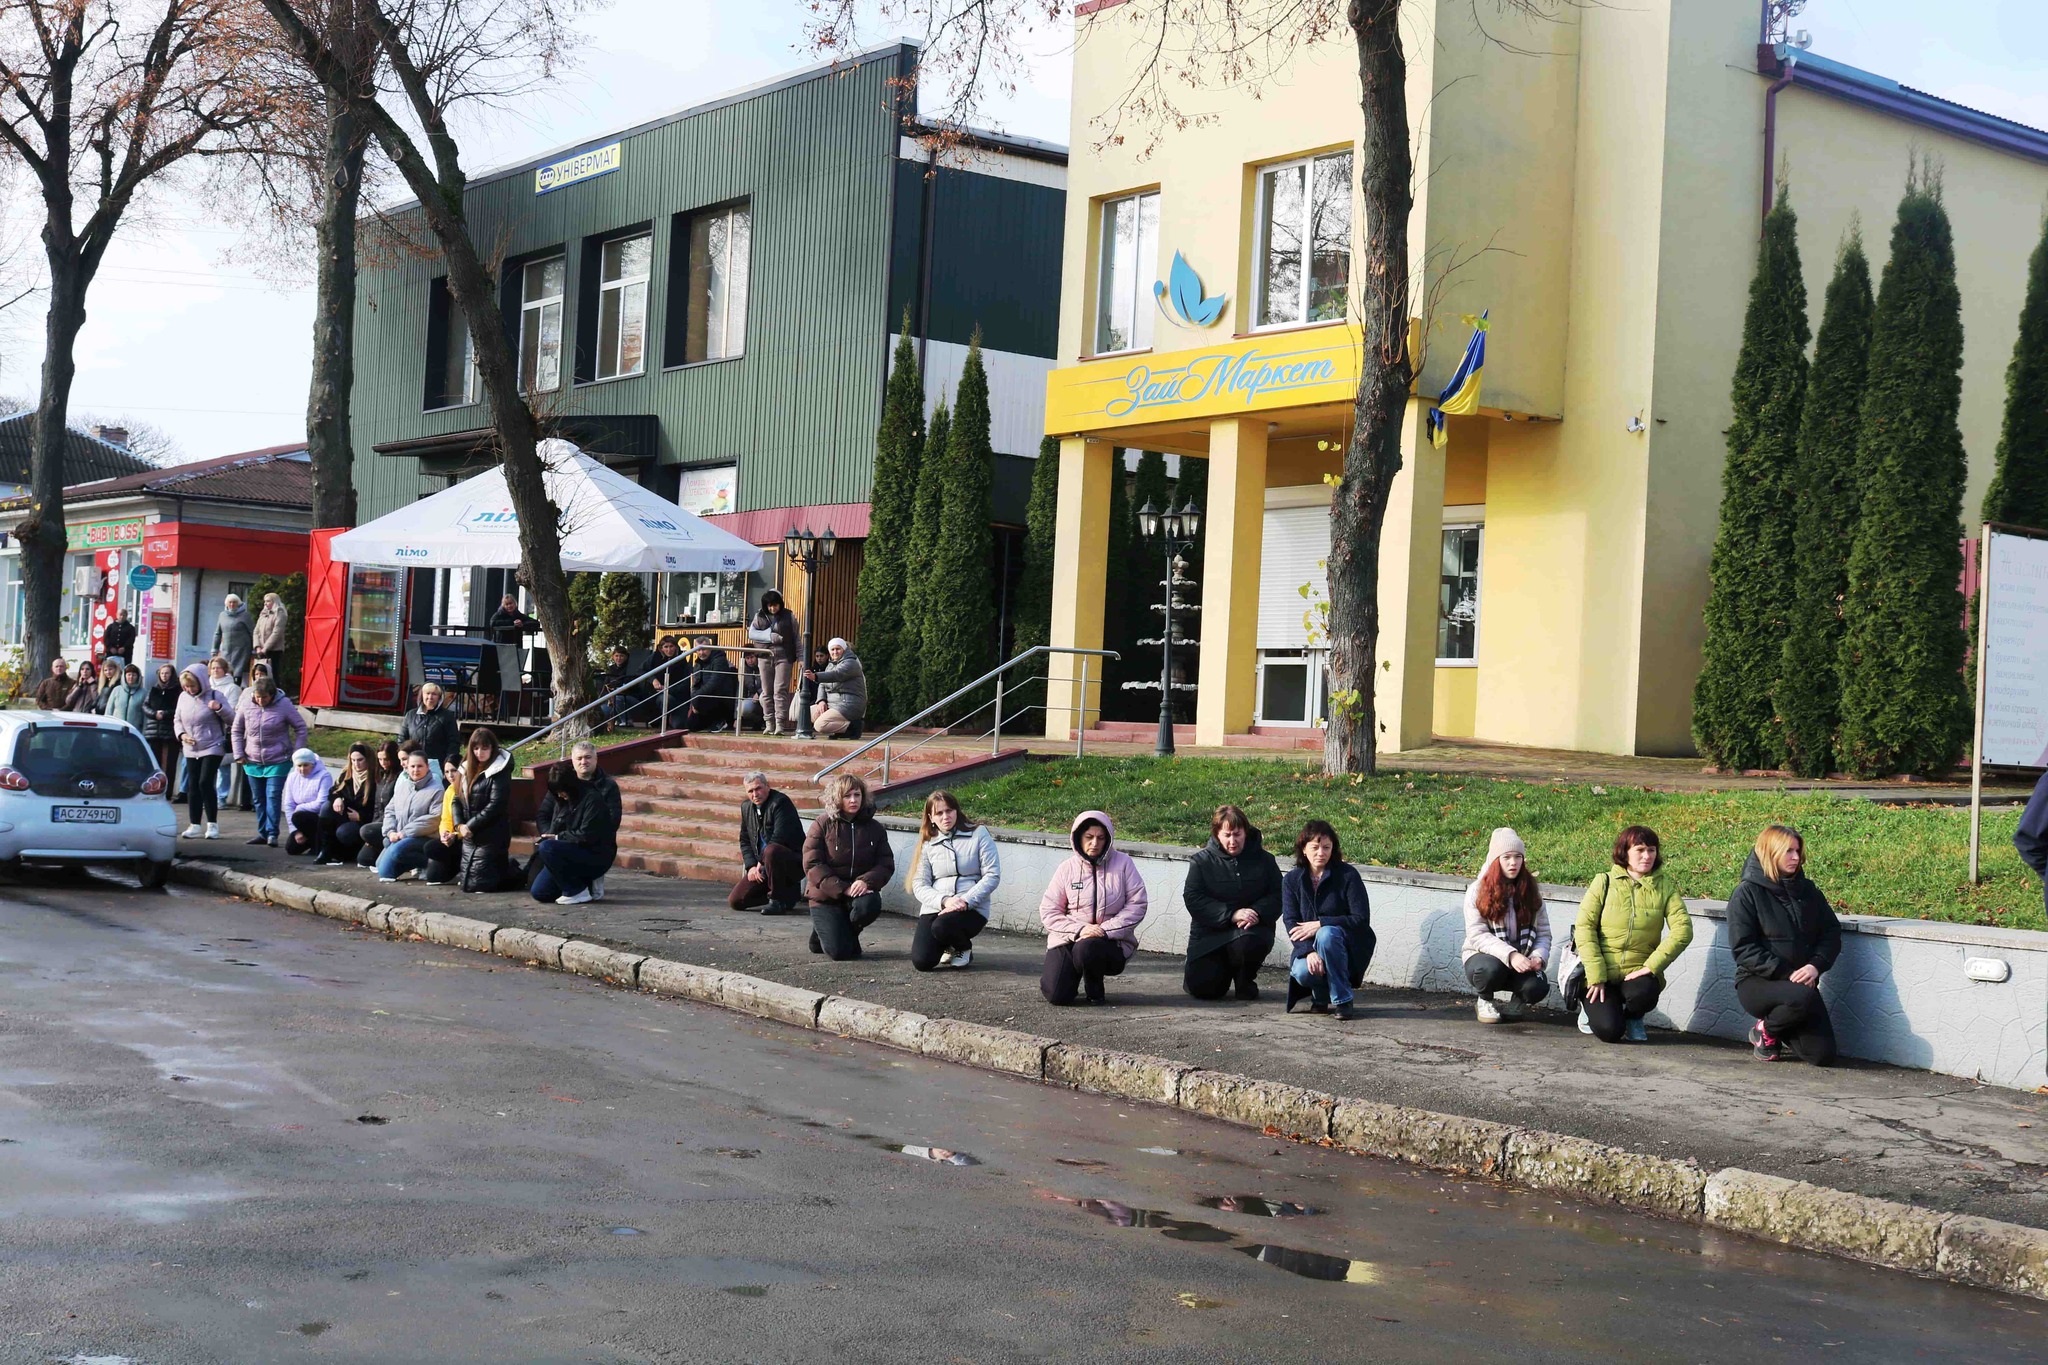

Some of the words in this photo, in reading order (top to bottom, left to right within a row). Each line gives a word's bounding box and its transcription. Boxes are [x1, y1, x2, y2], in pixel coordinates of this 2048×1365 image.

[556, 147, 617, 182] УНІВЕРМАГ
[1105, 365, 1181, 417] Зай
[1178, 349, 1335, 405] Маркет
[90, 526, 113, 543] BABY
[114, 522, 139, 541] BOSS
[395, 545, 428, 557] лімо
[60, 808, 75, 819] AC
[76, 809, 100, 819] 2749
